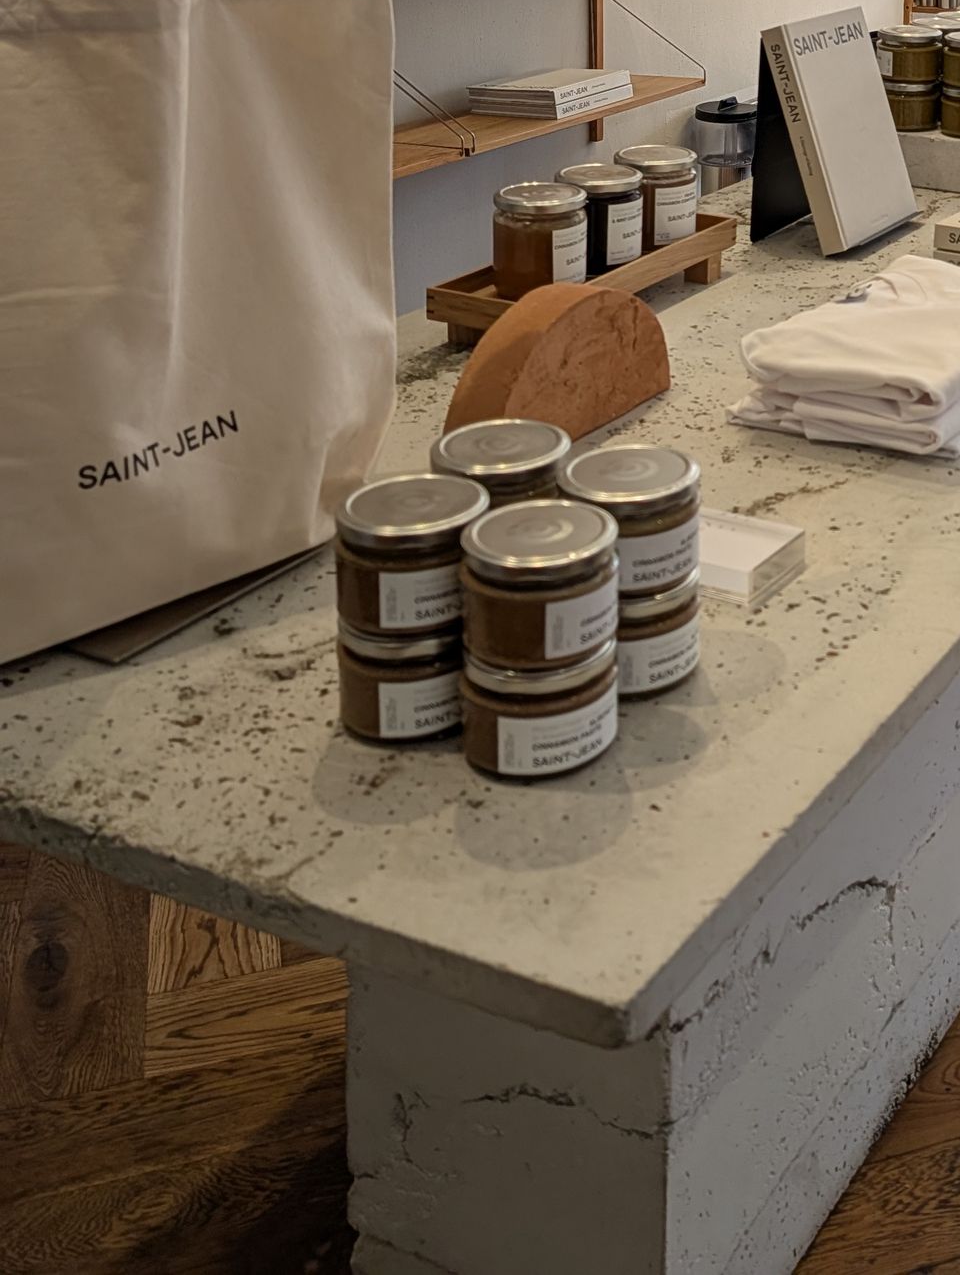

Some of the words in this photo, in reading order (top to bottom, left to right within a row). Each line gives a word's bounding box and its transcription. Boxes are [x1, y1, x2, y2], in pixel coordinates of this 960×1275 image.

[793, 22, 865, 56] SAINT-JEAN
[560, 84, 588, 100] SAINT-JEAN
[770, 44, 801, 123] SAINT-JEAN
[561, 100, 590, 115] SAINT-JEAN
[78, 410, 239, 489] SAINT-JEAN
[633, 557, 692, 582] SAINT-JEAN
[532, 738, 603, 768] SAINT-JEAN
